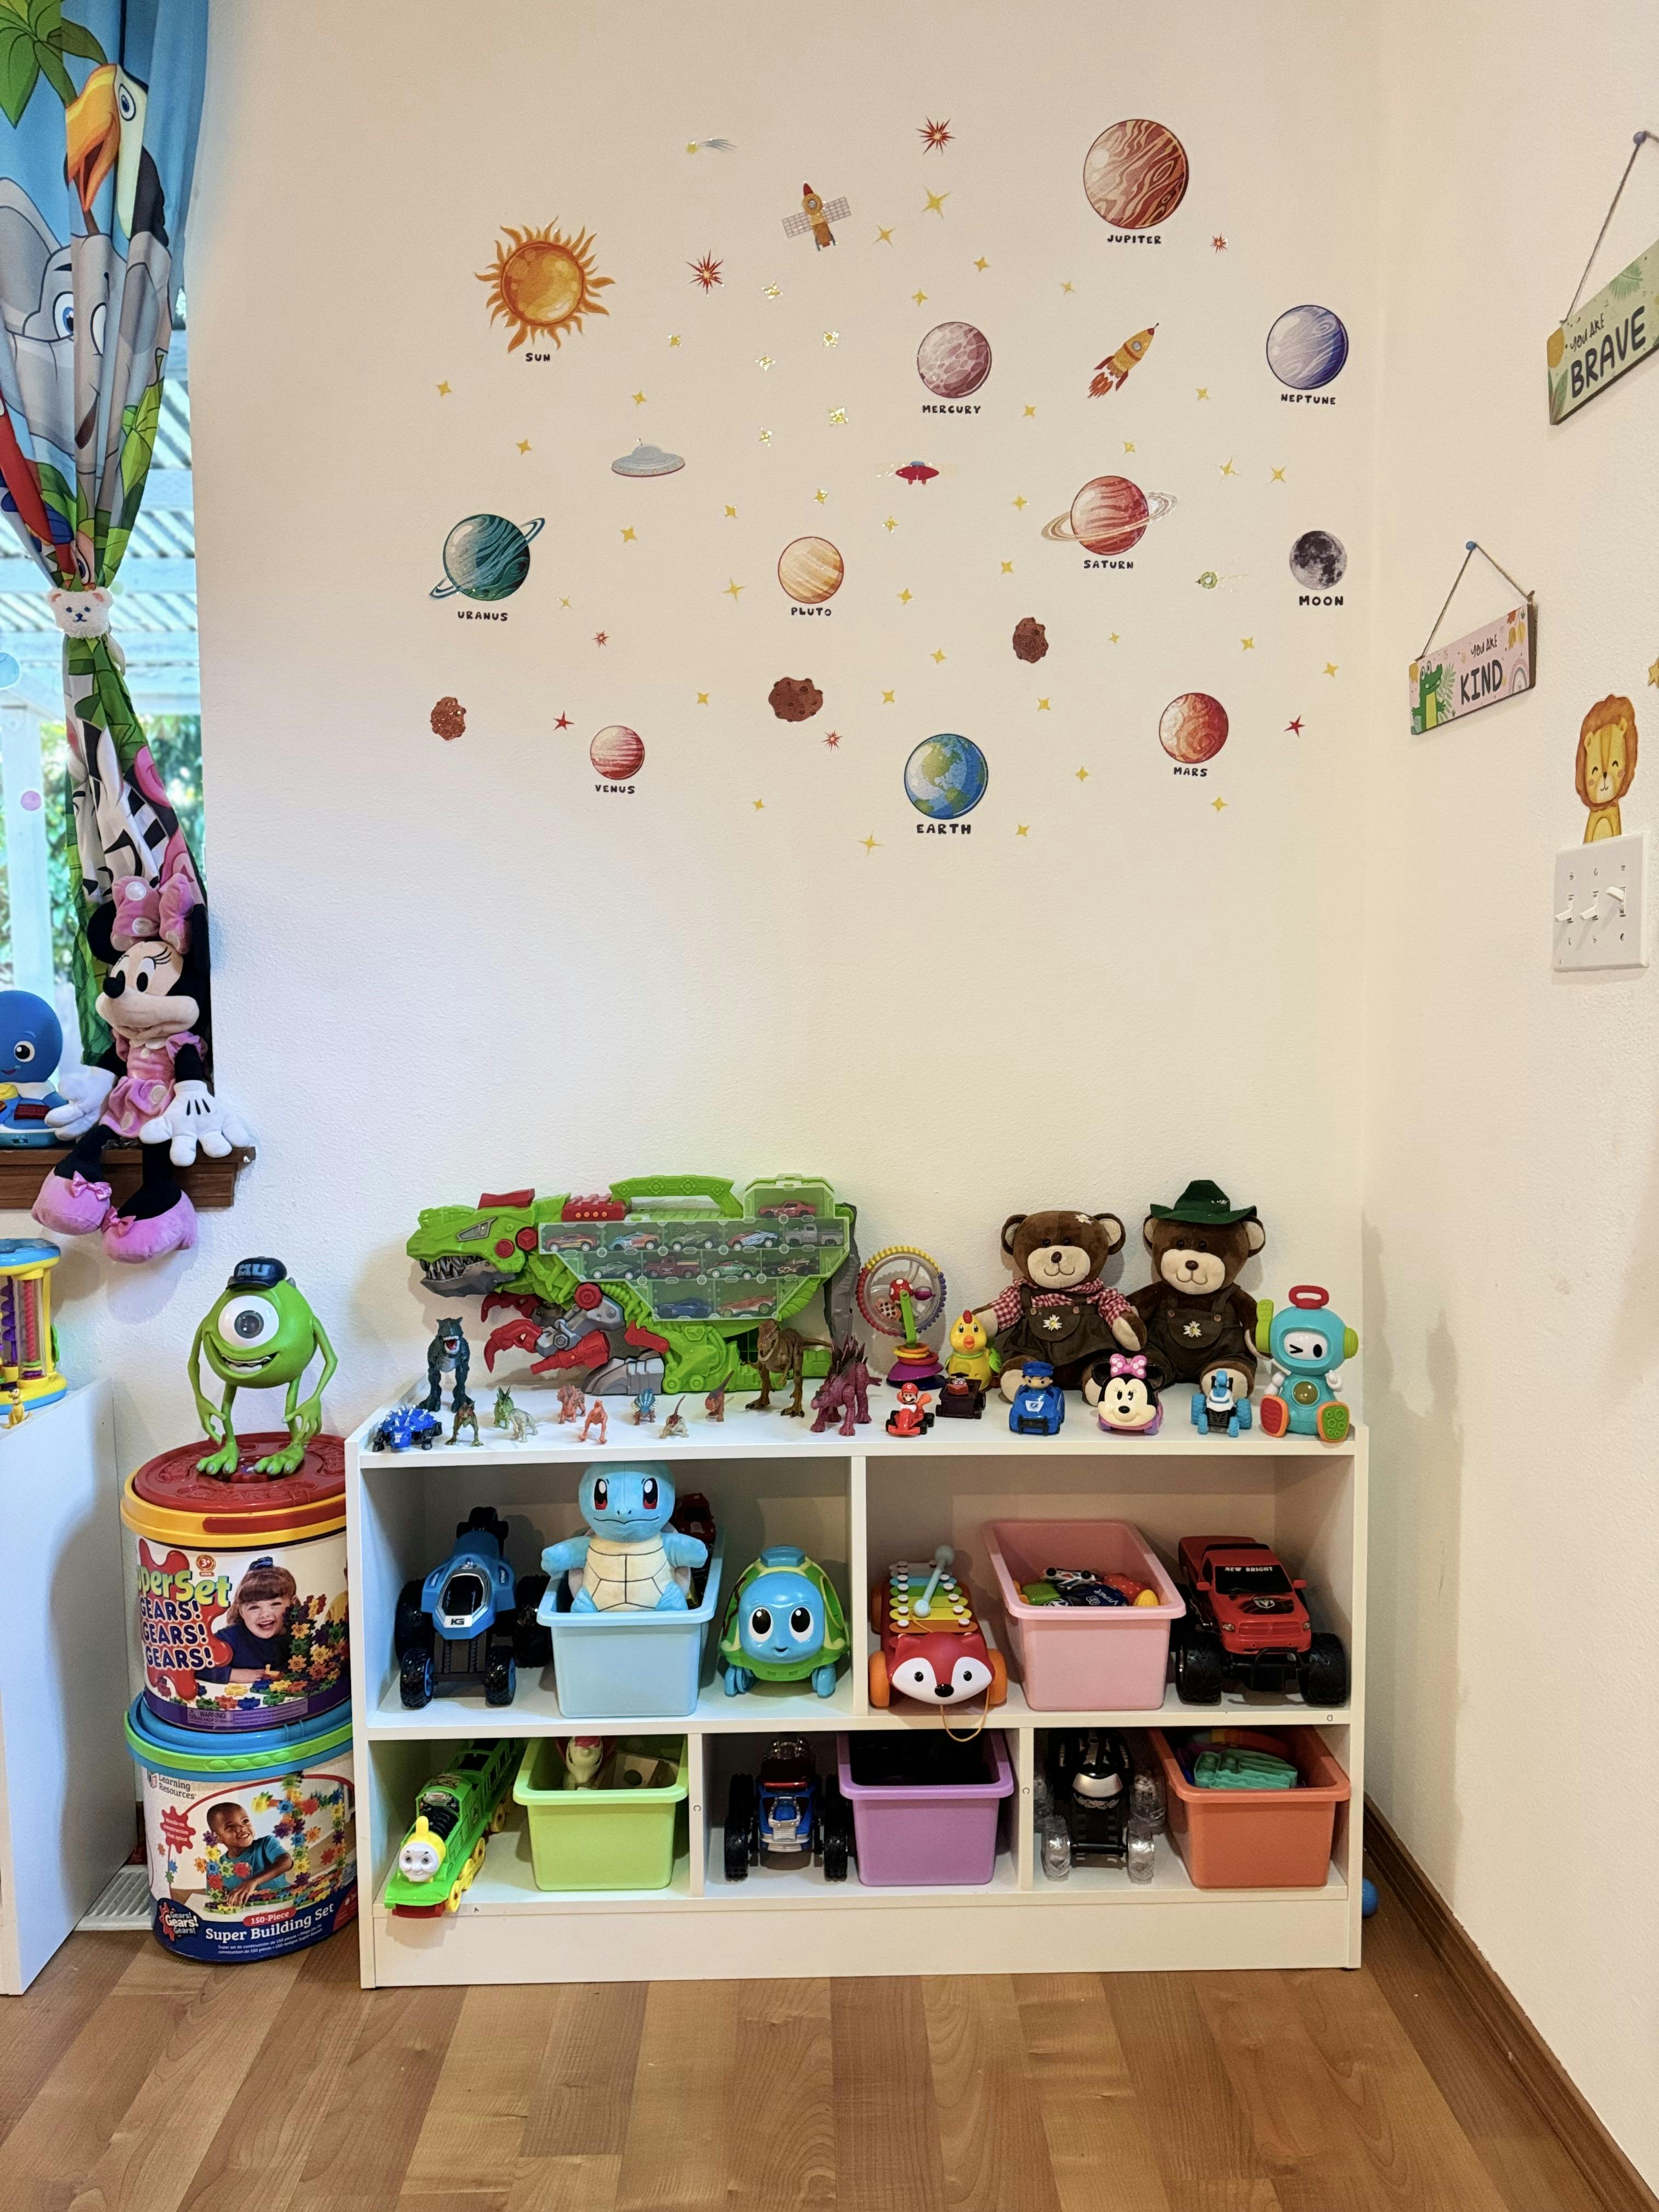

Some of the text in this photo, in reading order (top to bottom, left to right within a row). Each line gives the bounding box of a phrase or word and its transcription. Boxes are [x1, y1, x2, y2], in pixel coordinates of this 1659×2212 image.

[1107, 234, 1162, 245] JUPITER
[1570, 313, 1605, 352] YOU ARE
[525, 352, 550, 362] SUN
[1571, 306, 1646, 398] BRAVE
[1280, 393, 1336, 405] NEPTUNE
[922, 404, 981, 414] MERCURY
[1084, 560, 1133, 569] SATURN
[1299, 595, 1344, 606] MOON
[458, 611, 508, 622] URANUS
[791, 607, 832, 617] PLUTO
[1470, 634, 1498, 658] YOU ARE
[1460, 659, 1503, 706] KIND
[1173, 766, 1208, 777] MARS
[595, 785, 635, 794] VENUS
[916, 823, 972, 835] EARTH
[140, 1596, 201, 1621] GEARS!
[142, 1620, 207, 1645] GEARS!
[145, 1645, 213, 1669] GEARS!
[159, 1774, 190, 1792] Learning
[159, 1782, 195, 1800] Resources
[165, 1915, 199, 1927] Gears!
[205, 1928, 247, 1943] Super
[250, 1915, 312, 1940] Building
[314, 1903, 334, 1921] Set
[250, 1911, 290, 1925] 150-Piece
